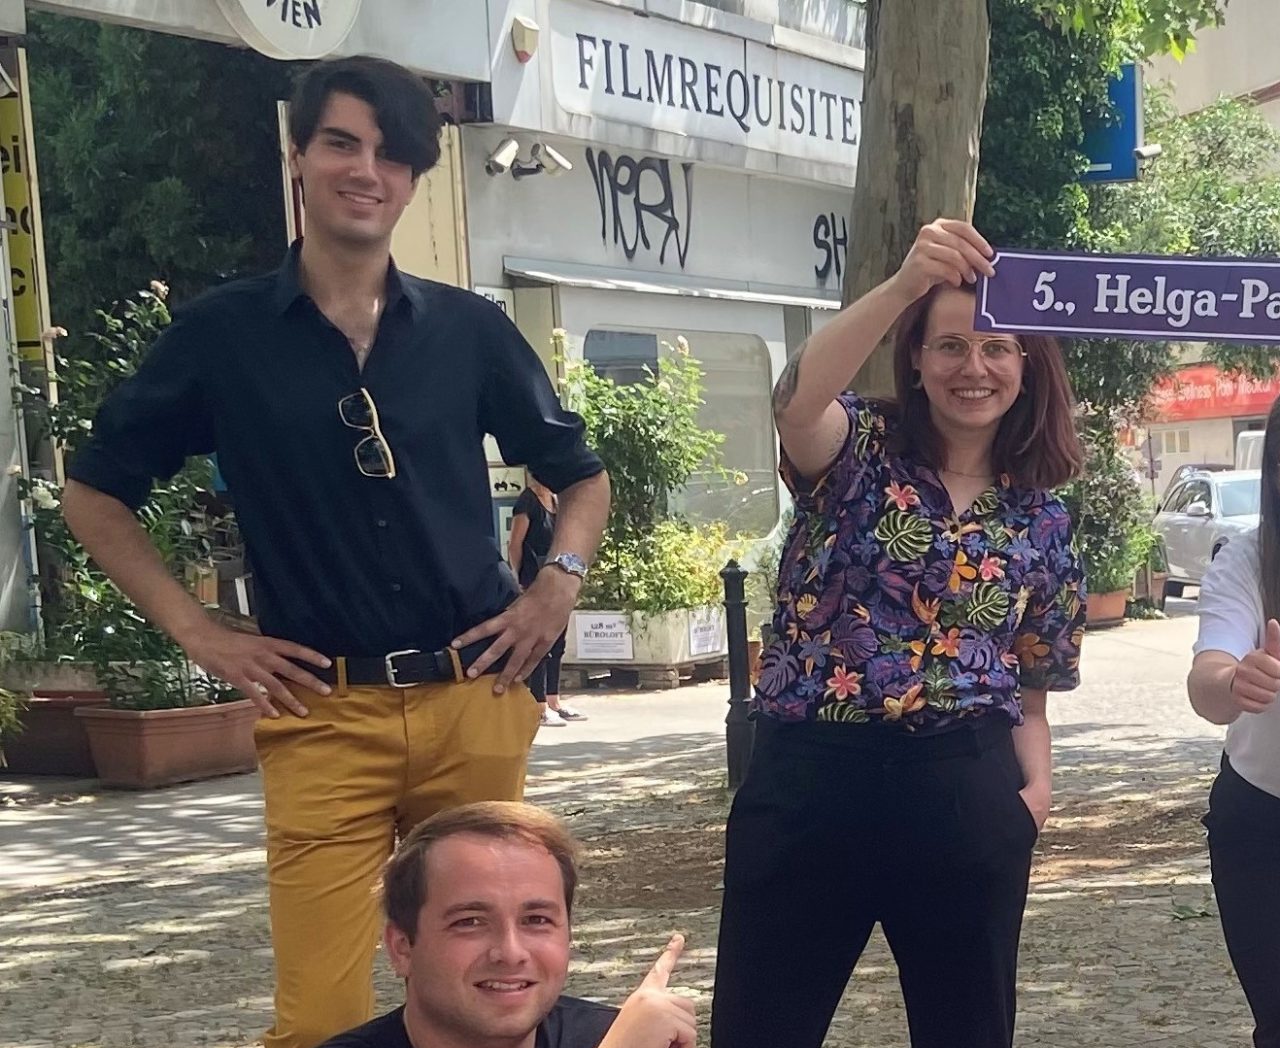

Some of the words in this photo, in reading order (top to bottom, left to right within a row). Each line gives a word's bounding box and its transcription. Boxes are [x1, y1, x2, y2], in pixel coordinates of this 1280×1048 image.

[266, 0, 322, 29] IEN
[576, 32, 862, 146] FILMREQUISITE
[1033, 271, 1076, 316] 5.,
